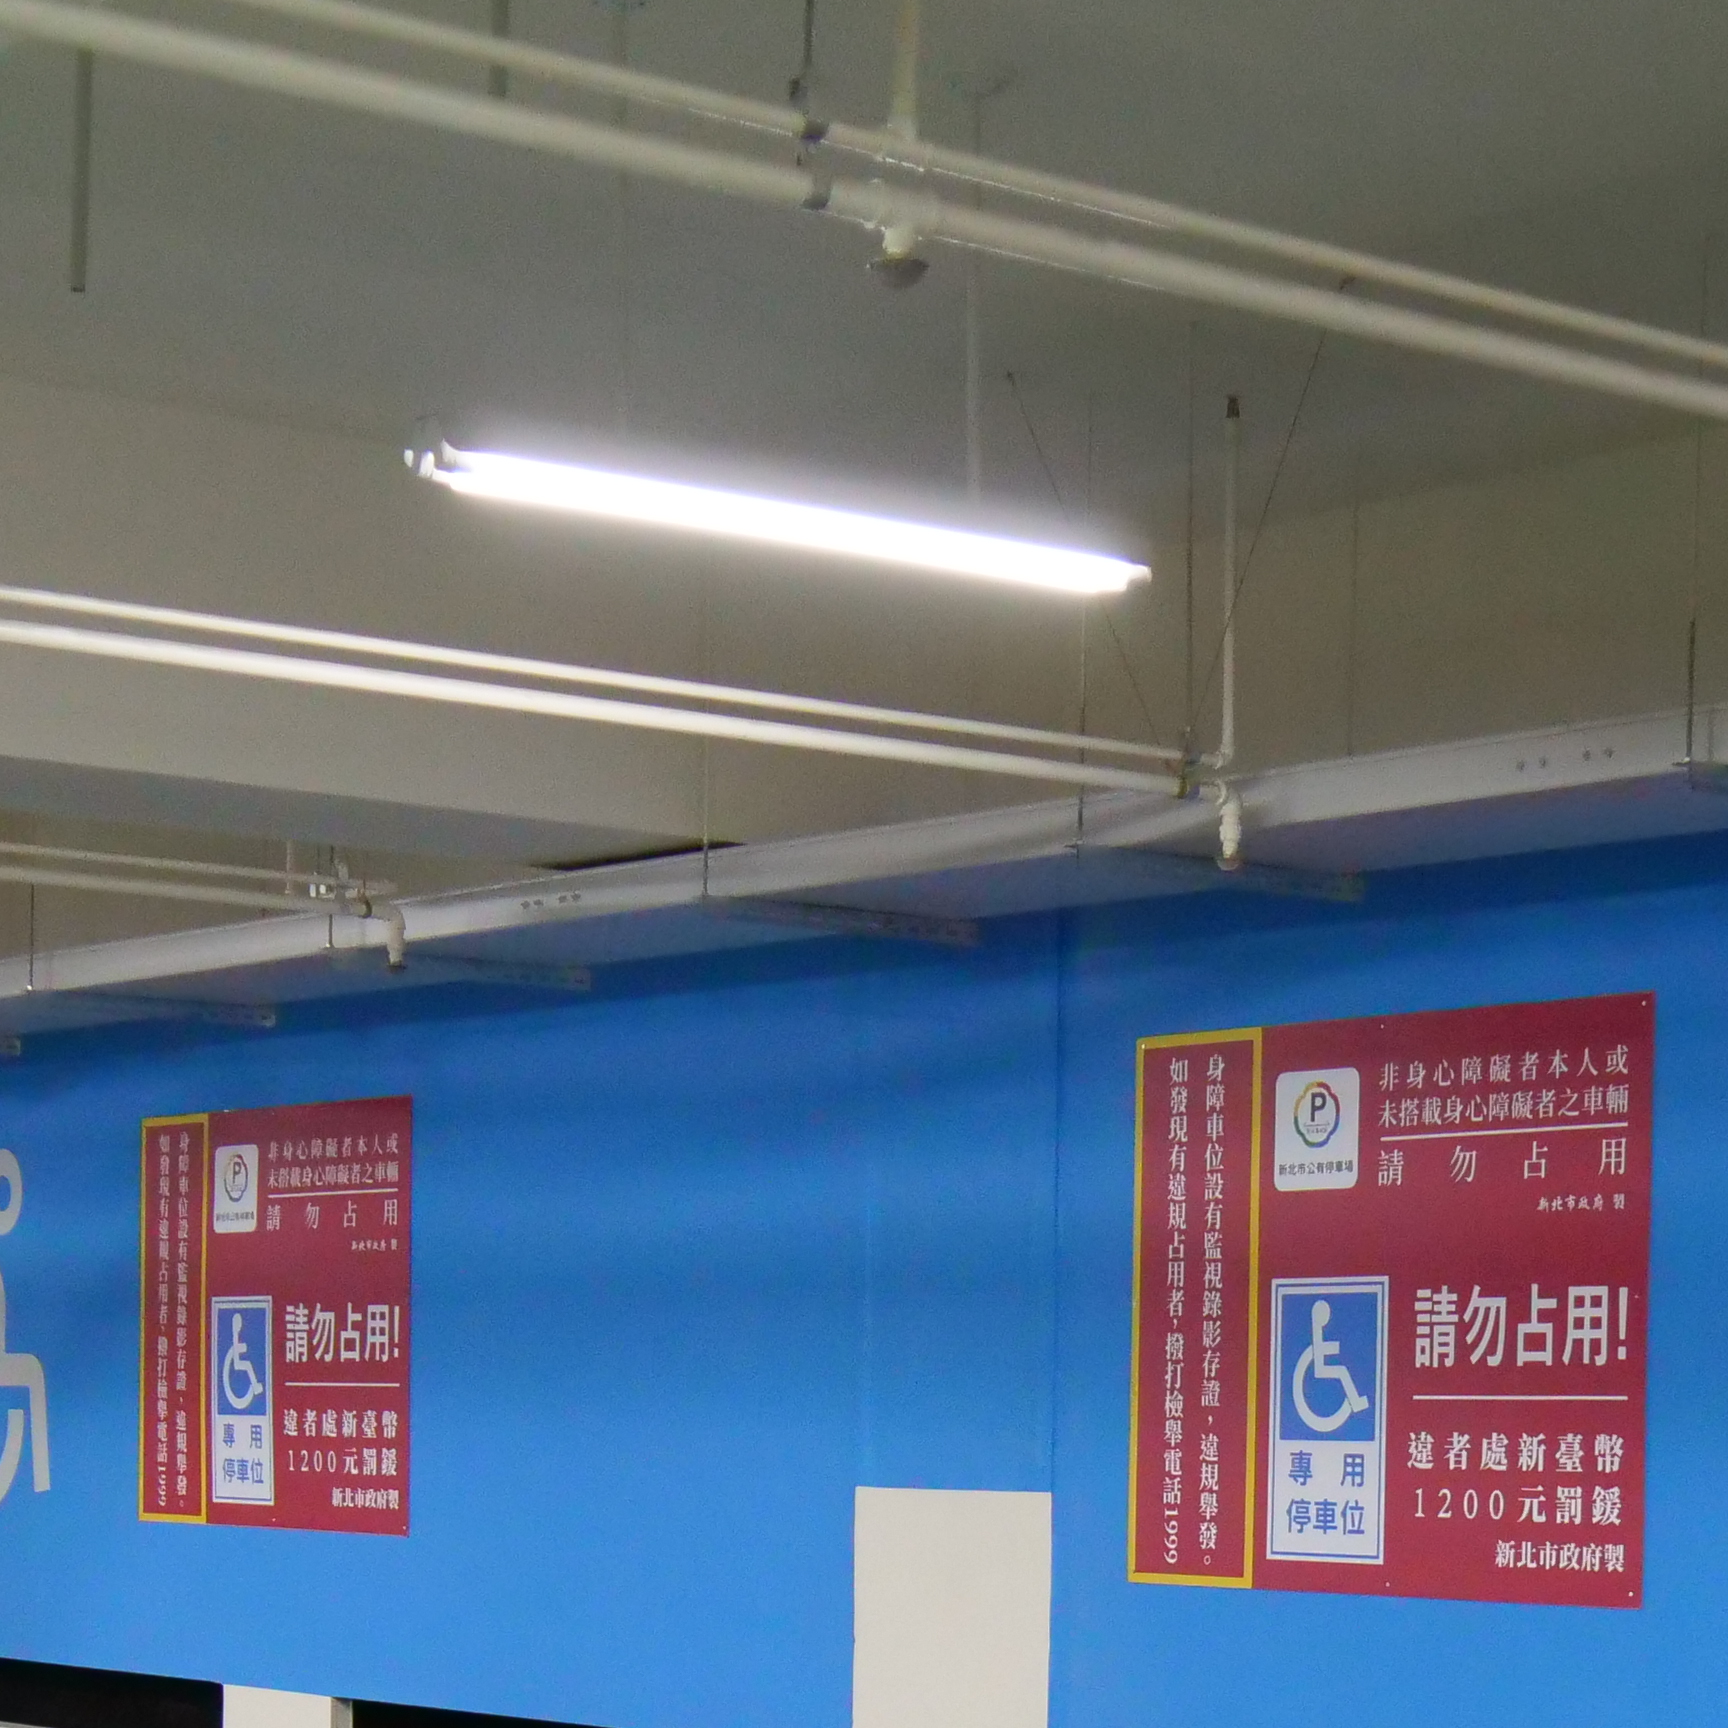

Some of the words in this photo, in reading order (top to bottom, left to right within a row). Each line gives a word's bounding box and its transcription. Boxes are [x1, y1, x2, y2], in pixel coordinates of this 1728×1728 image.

[1379, 1044, 1630, 1092] 非身心障礙者本人或
[1310, 1091, 1327, 1123] P
[1377, 1083, 1630, 1129] 未搭載身心障礙者之車輛
[221, 1457, 265, 1486] 停車位
[1406, 1431, 1625, 1474] 違者處新臺幣
[1286, 1498, 1366, 1537] 停車位
[1493, 1539, 1627, 1573] 新北市政府製
